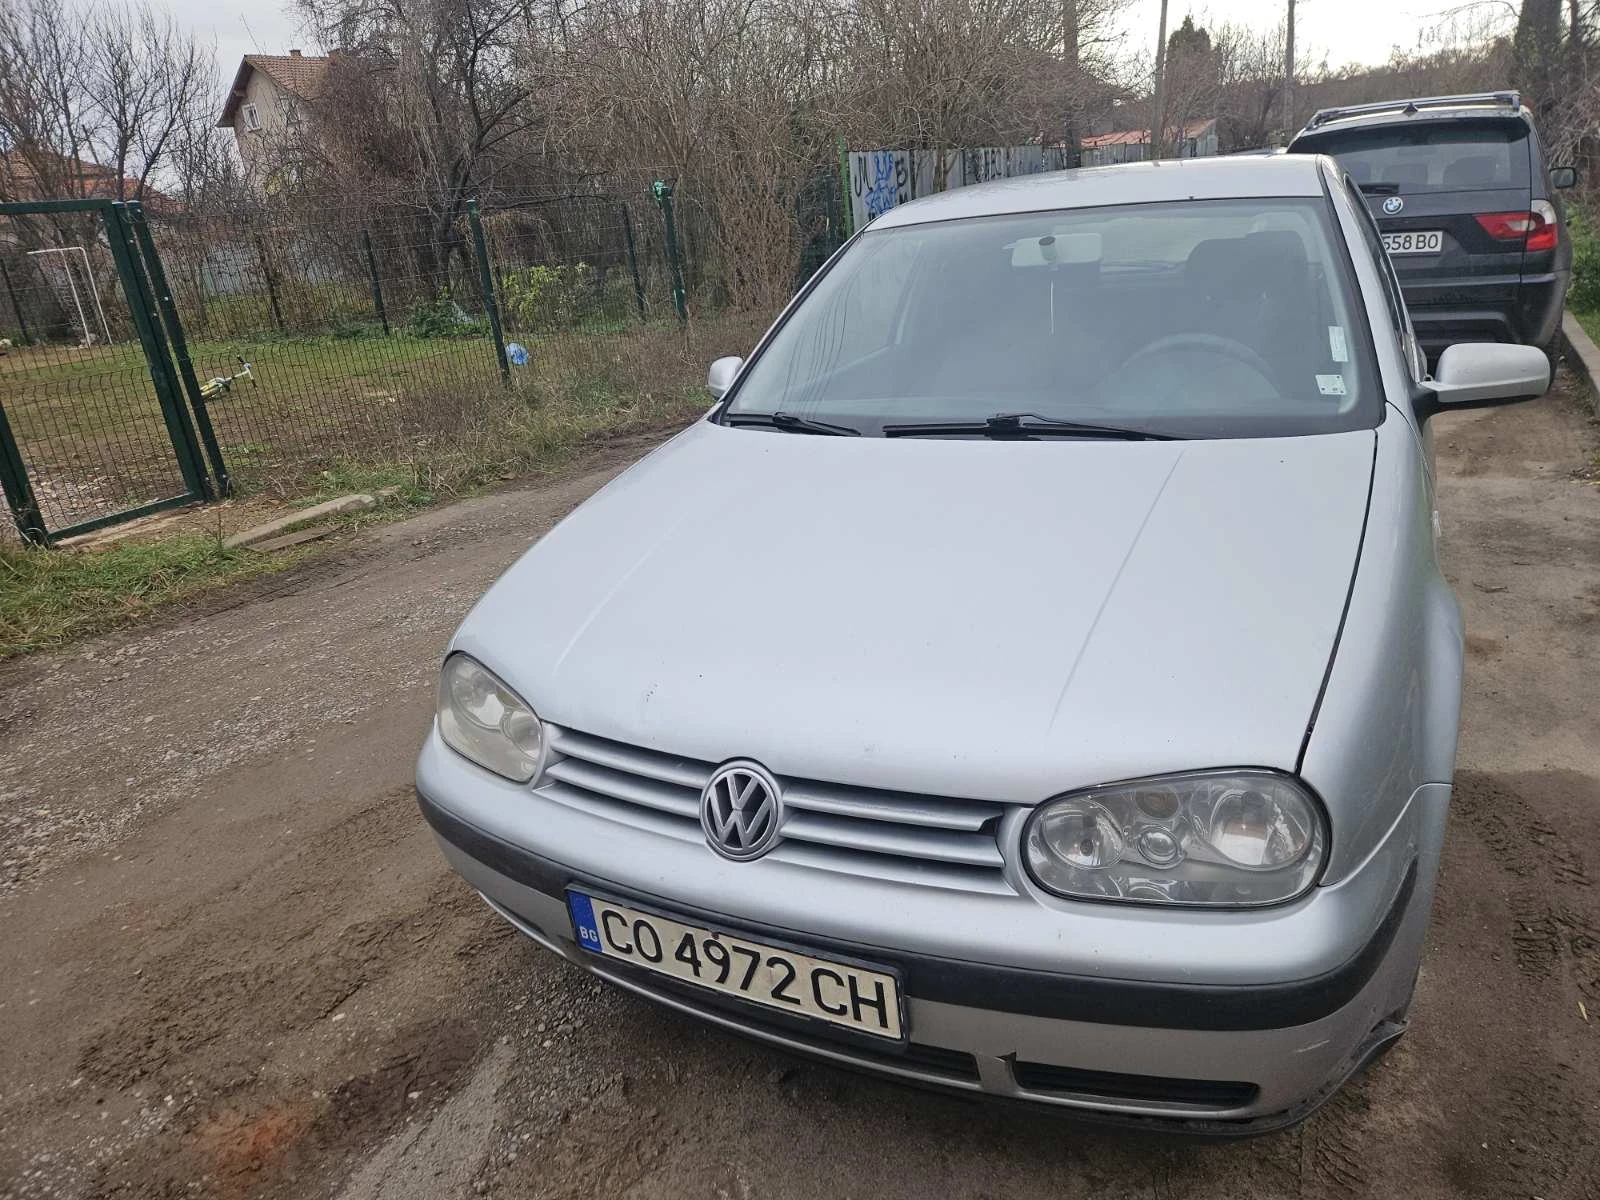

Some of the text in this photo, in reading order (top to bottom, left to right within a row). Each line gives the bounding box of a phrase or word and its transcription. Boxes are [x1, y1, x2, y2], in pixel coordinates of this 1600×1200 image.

[703, 765, 779, 856] VW
[580, 926, 598, 942] BG
[601, 909, 889, 1029] CO 4972 CH
